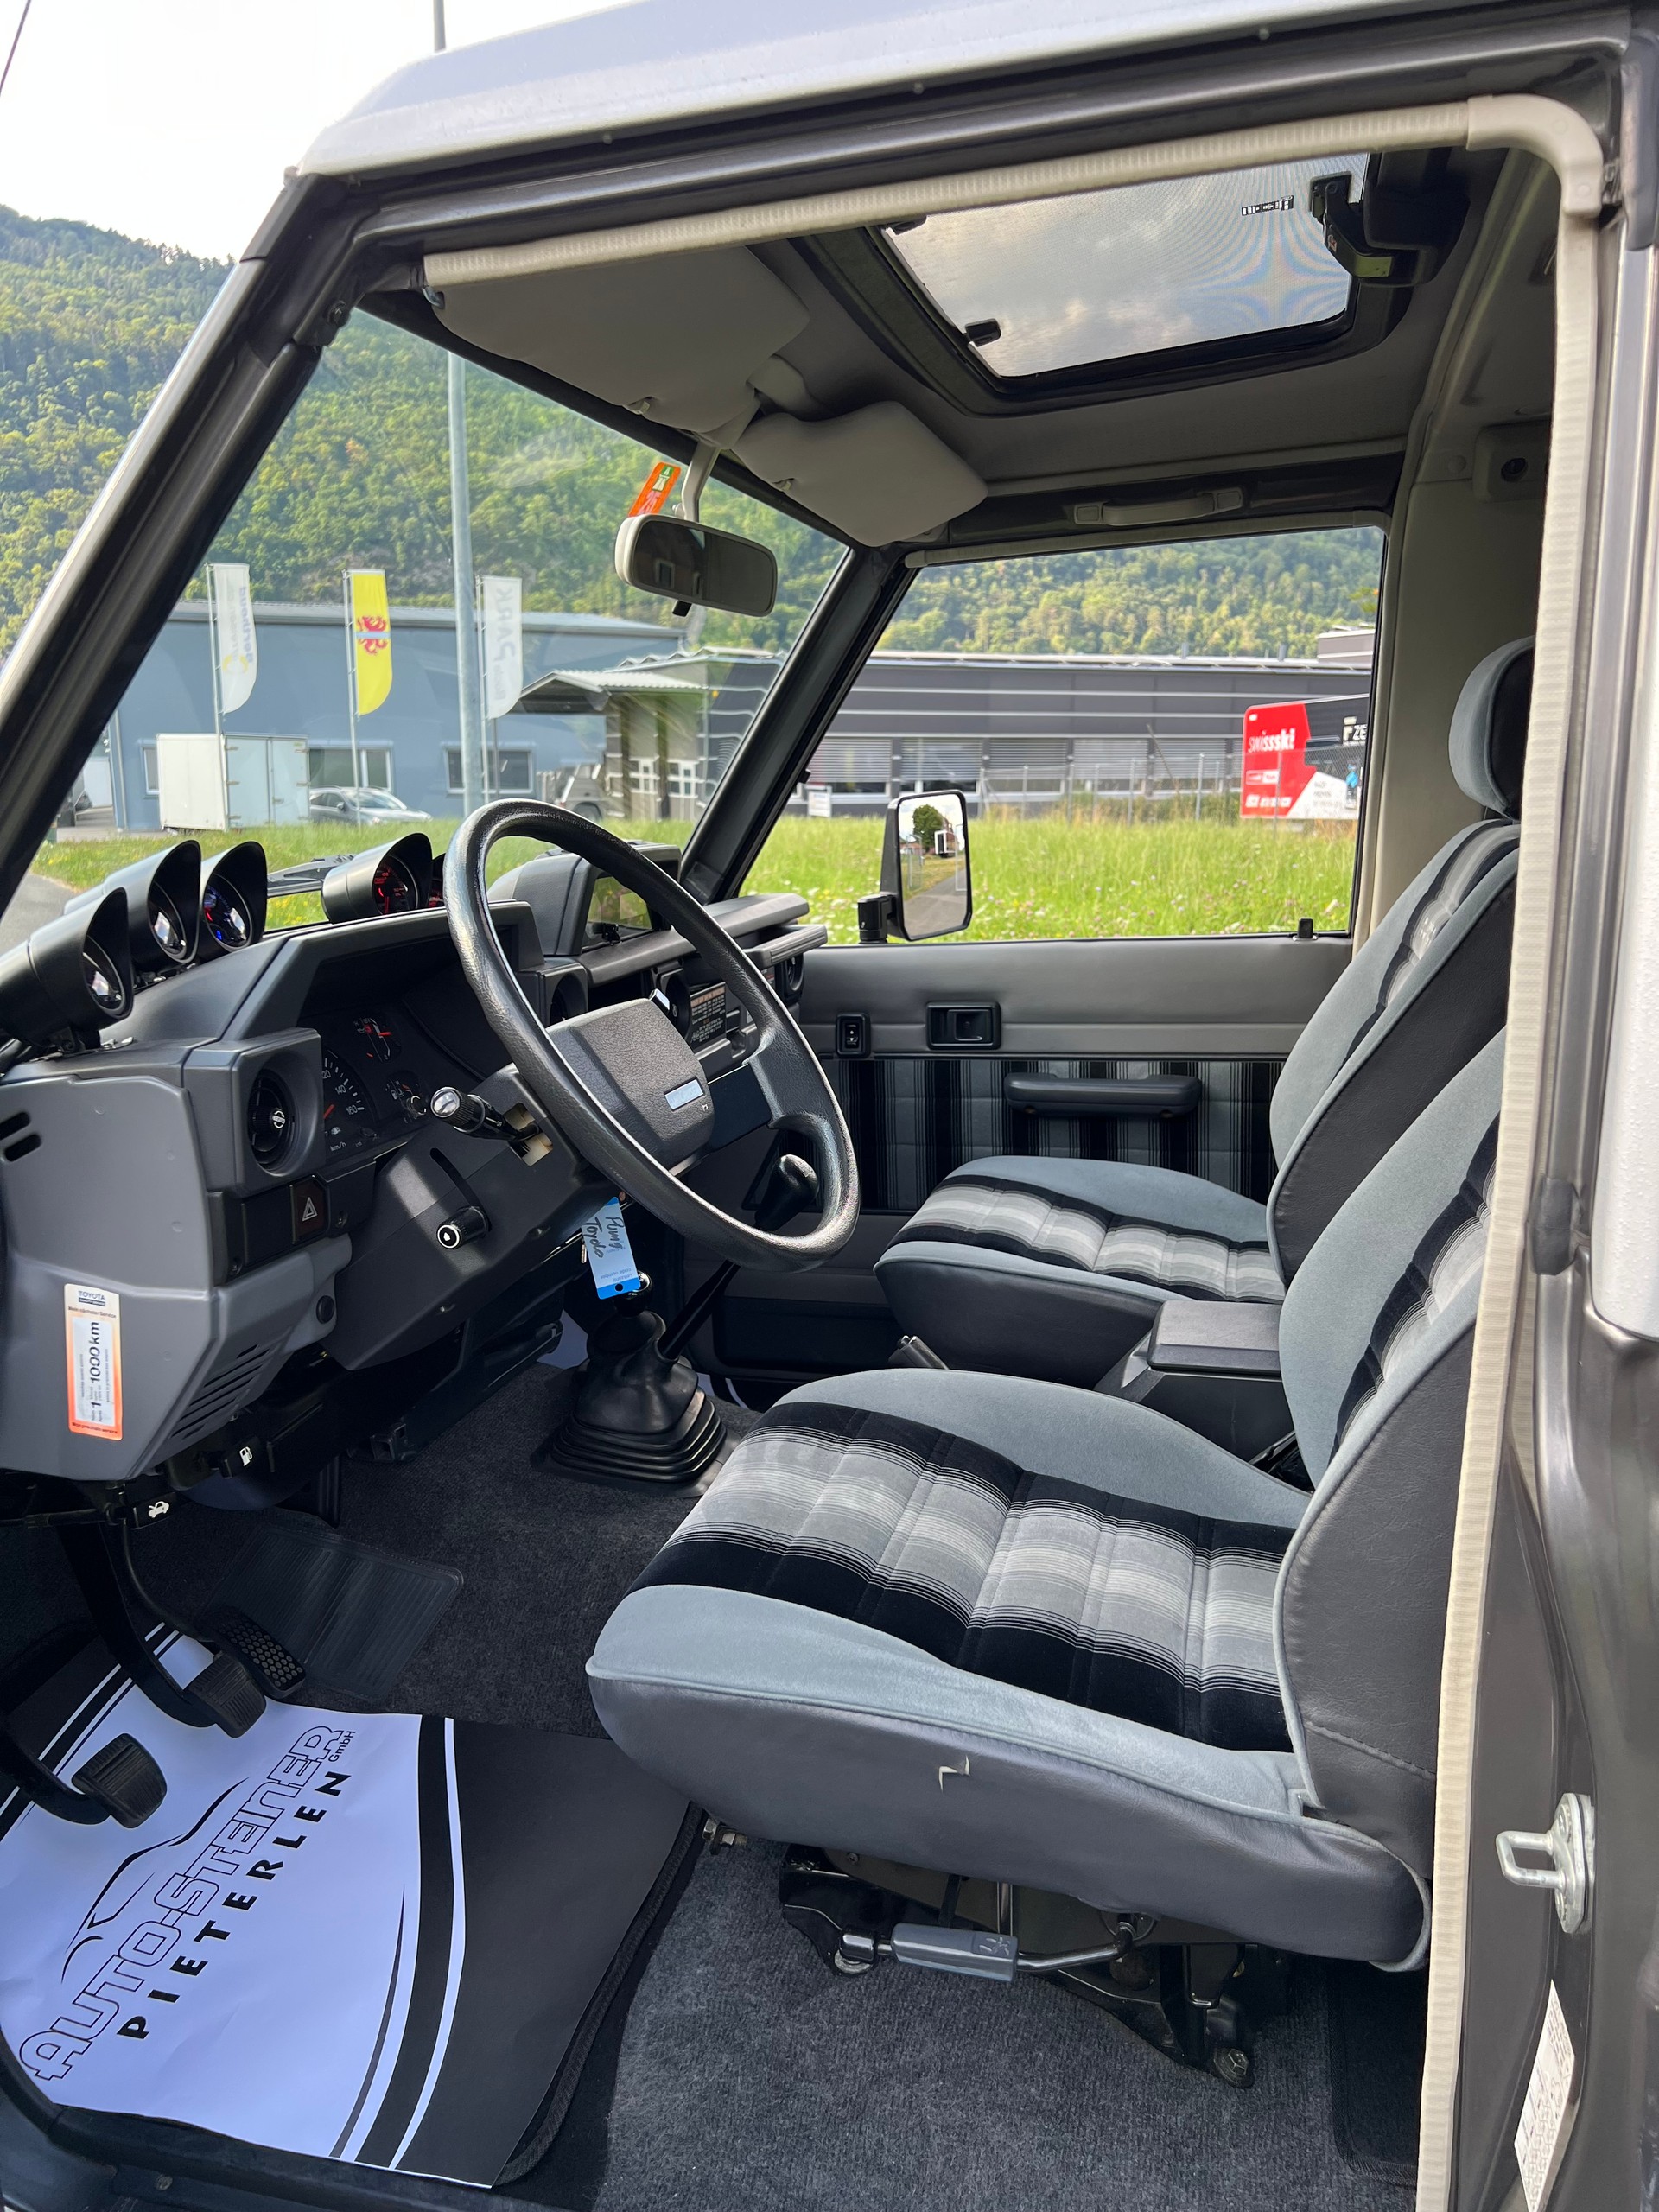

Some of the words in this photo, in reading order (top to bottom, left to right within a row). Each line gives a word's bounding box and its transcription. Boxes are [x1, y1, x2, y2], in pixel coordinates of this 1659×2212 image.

[321, 1070, 332, 1079] 20
[335, 1084, 346, 1095] 140
[329, 1141, 346, 1152] km/h
[79, 1290, 105, 1301] TOYOTA
[89, 1321, 100, 1345] km
[89, 1346, 101, 1382] 1000
[330, 1729, 357, 1763] GmbH
[19, 1726, 346, 2082] AUTO-STEINER
[117, 1771, 352, 2040] PIETERLEN
